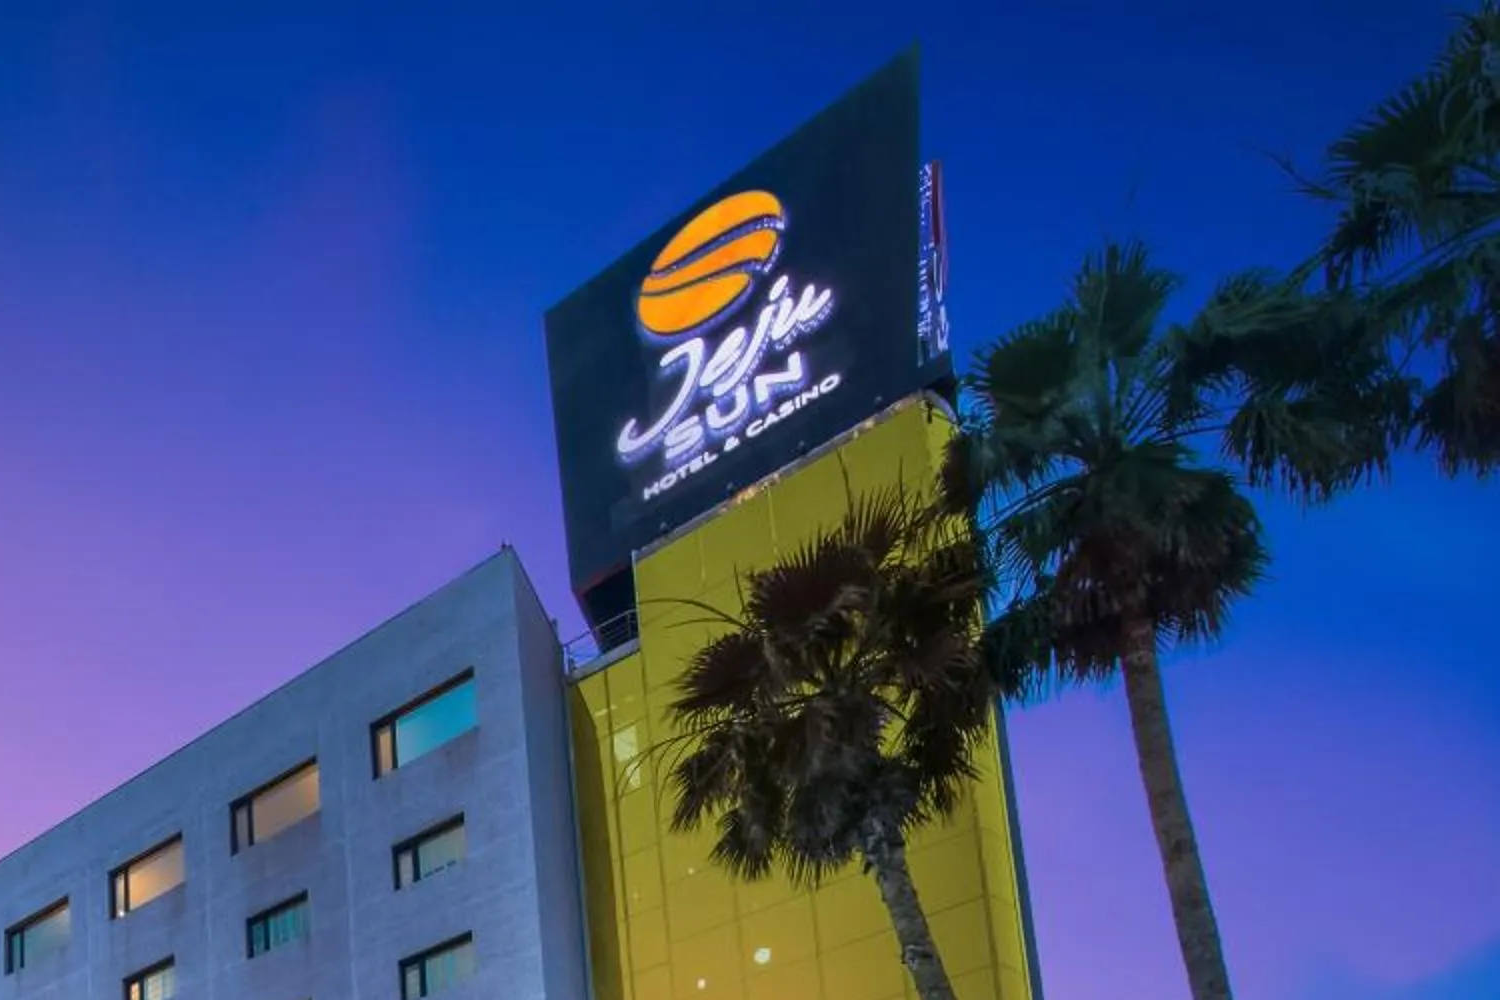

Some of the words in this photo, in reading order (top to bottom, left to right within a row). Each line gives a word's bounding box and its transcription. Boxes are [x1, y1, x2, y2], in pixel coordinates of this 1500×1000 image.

[617, 275, 833, 453] Jeju
[663, 352, 803, 460] SUN
[644, 452, 718, 500] HOTEL
[724, 436, 741, 452] &
[745, 373, 842, 438] CASINO
